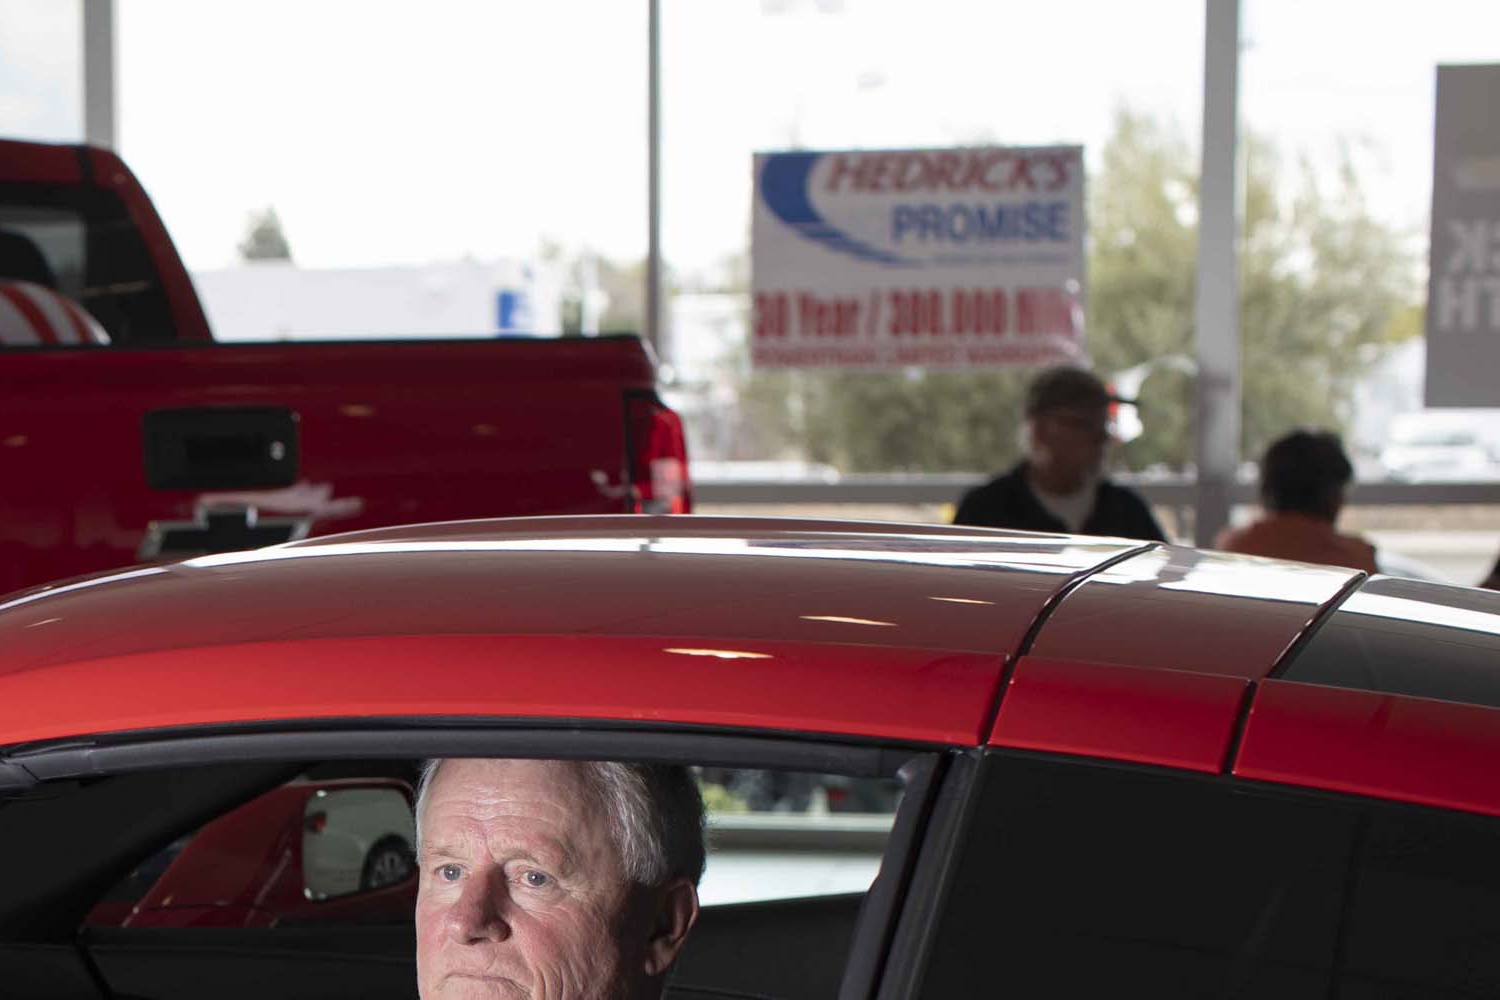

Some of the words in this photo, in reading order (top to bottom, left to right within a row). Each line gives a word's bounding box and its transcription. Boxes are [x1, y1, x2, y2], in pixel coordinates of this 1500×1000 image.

[891, 203, 1069, 242] PROMISE
[754, 288, 789, 336] 30
[794, 288, 859, 336] Year
